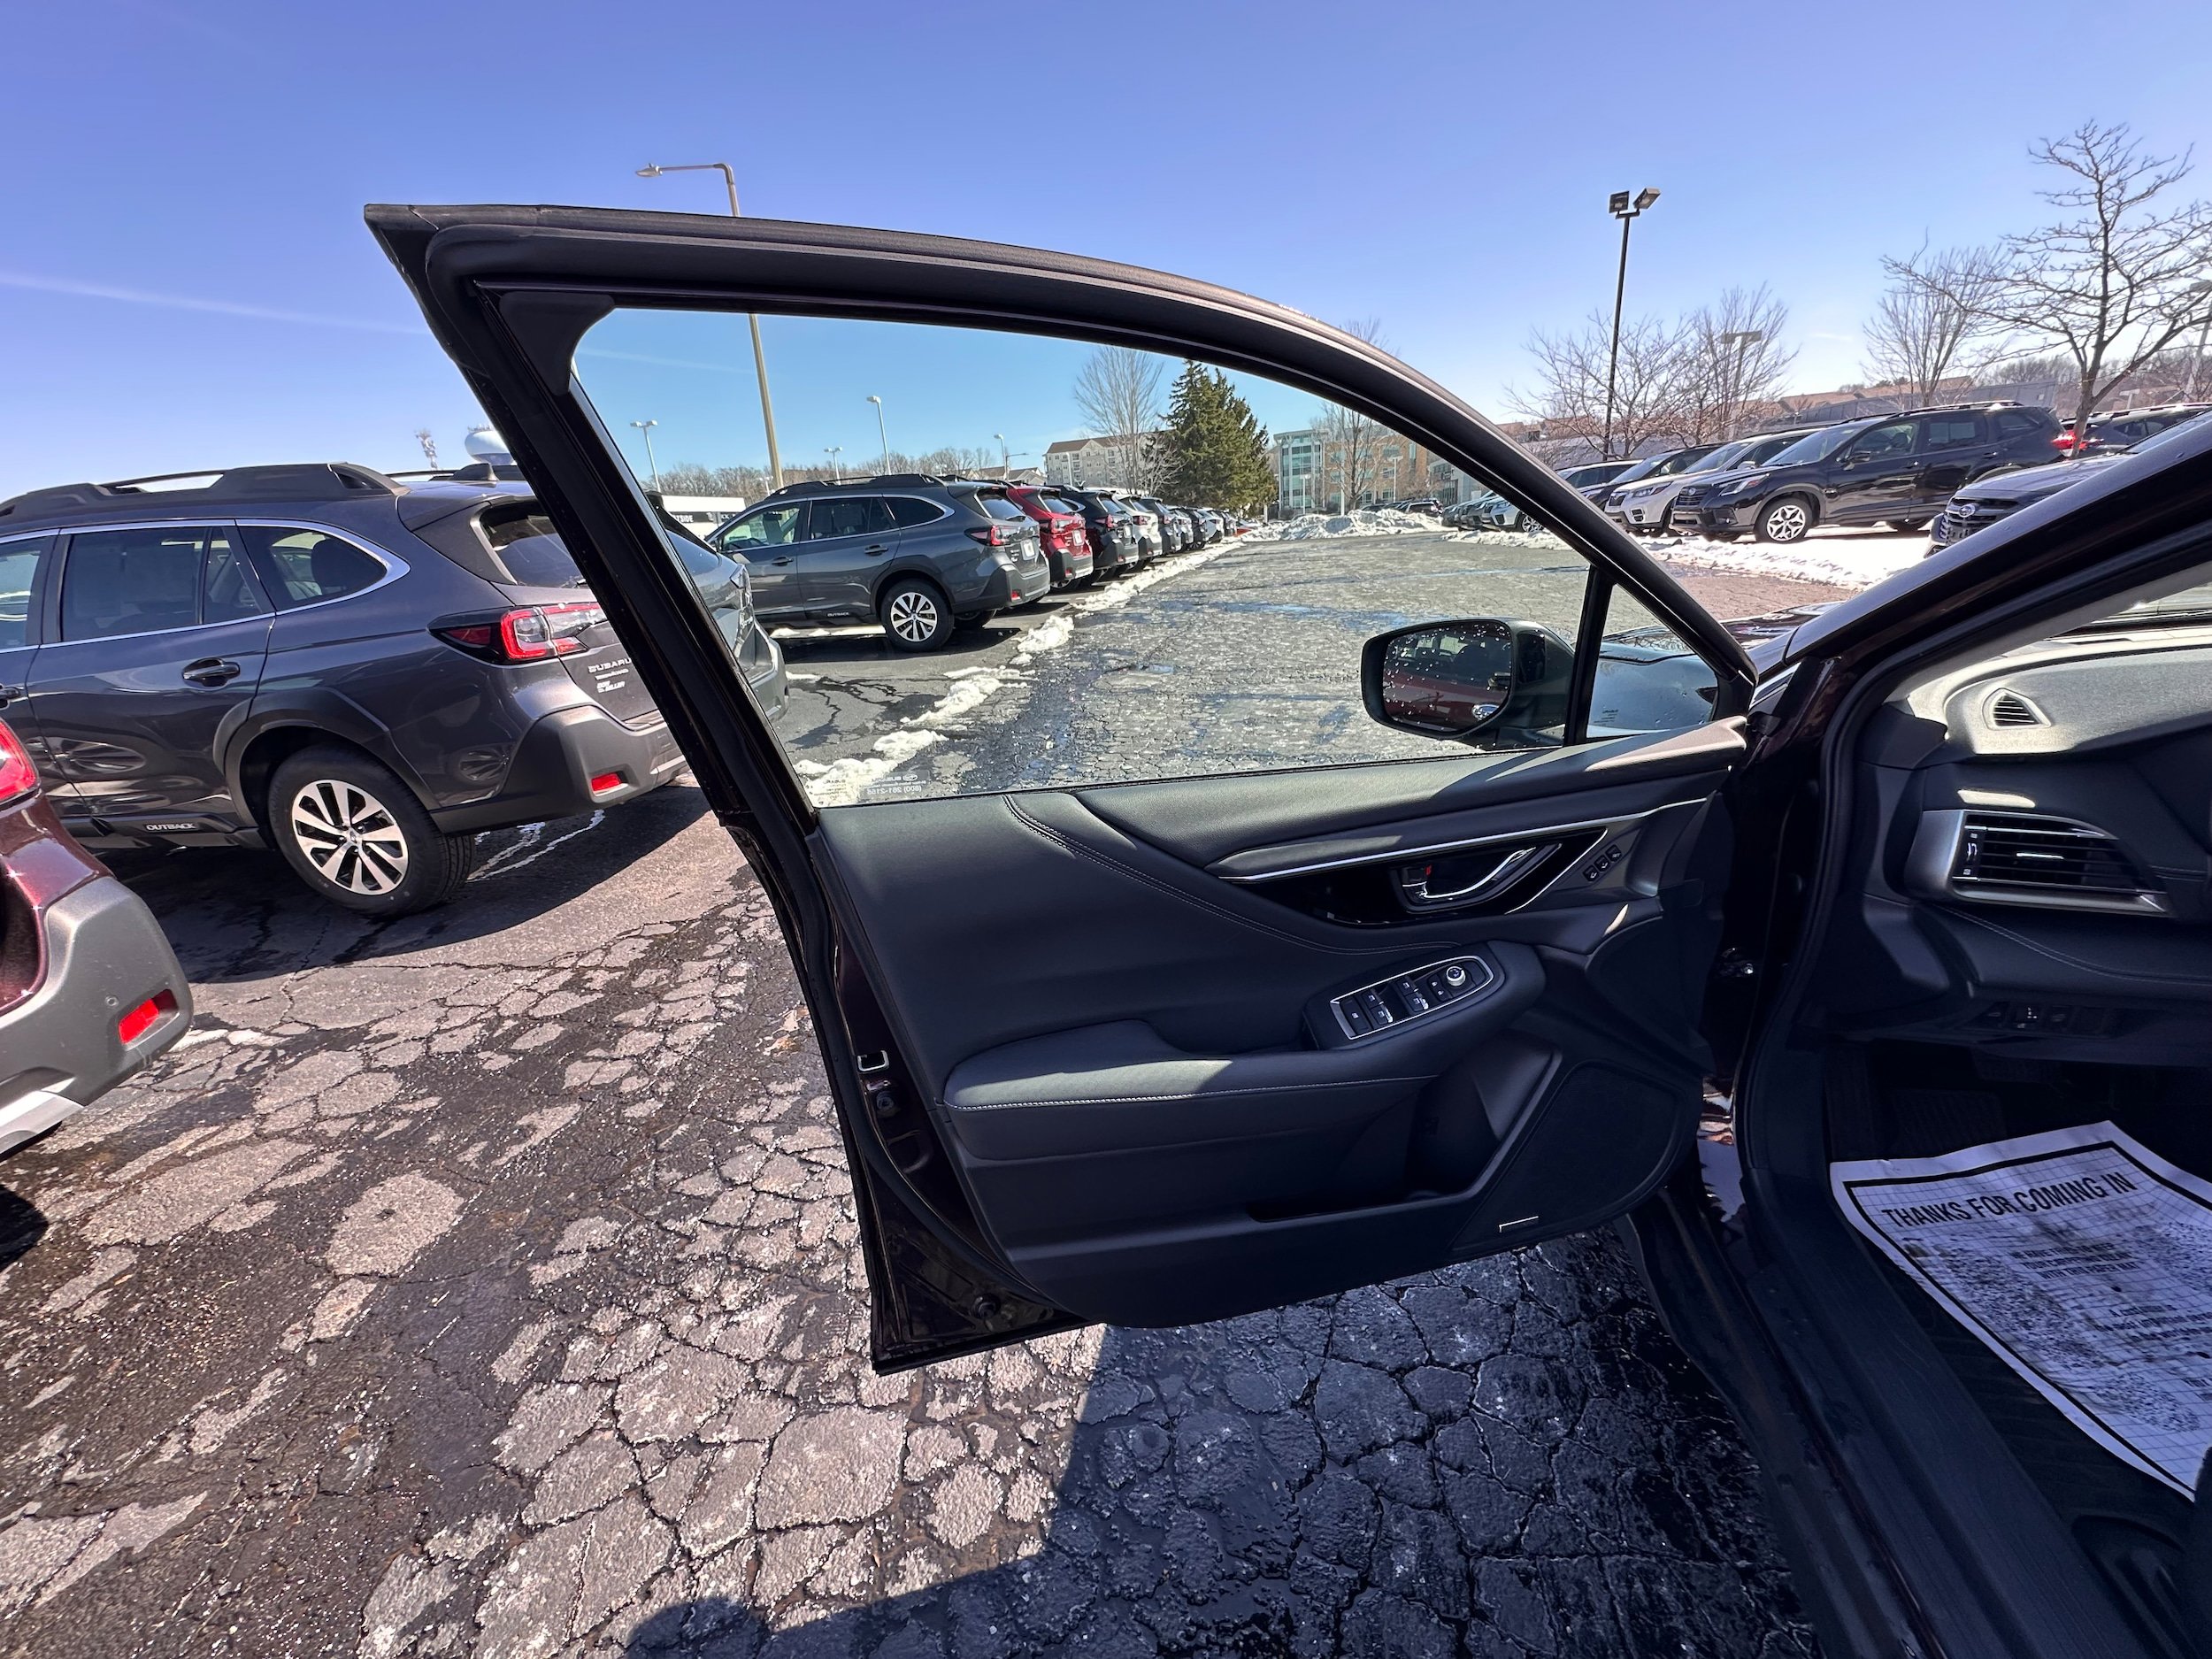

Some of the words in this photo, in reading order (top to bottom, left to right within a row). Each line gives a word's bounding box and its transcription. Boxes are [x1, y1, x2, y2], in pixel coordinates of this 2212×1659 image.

[588, 657, 633, 673] SUBARU
[1882, 1202, 1972, 1227] THANKS
[1967, 1195, 2018, 1217] FOR
[2014, 1177, 2109, 1212] COMING
[2104, 1171, 2138, 1194] IN
[2036, 1269, 2068, 1279] WITH
[2108, 1309, 2122, 1317] A
